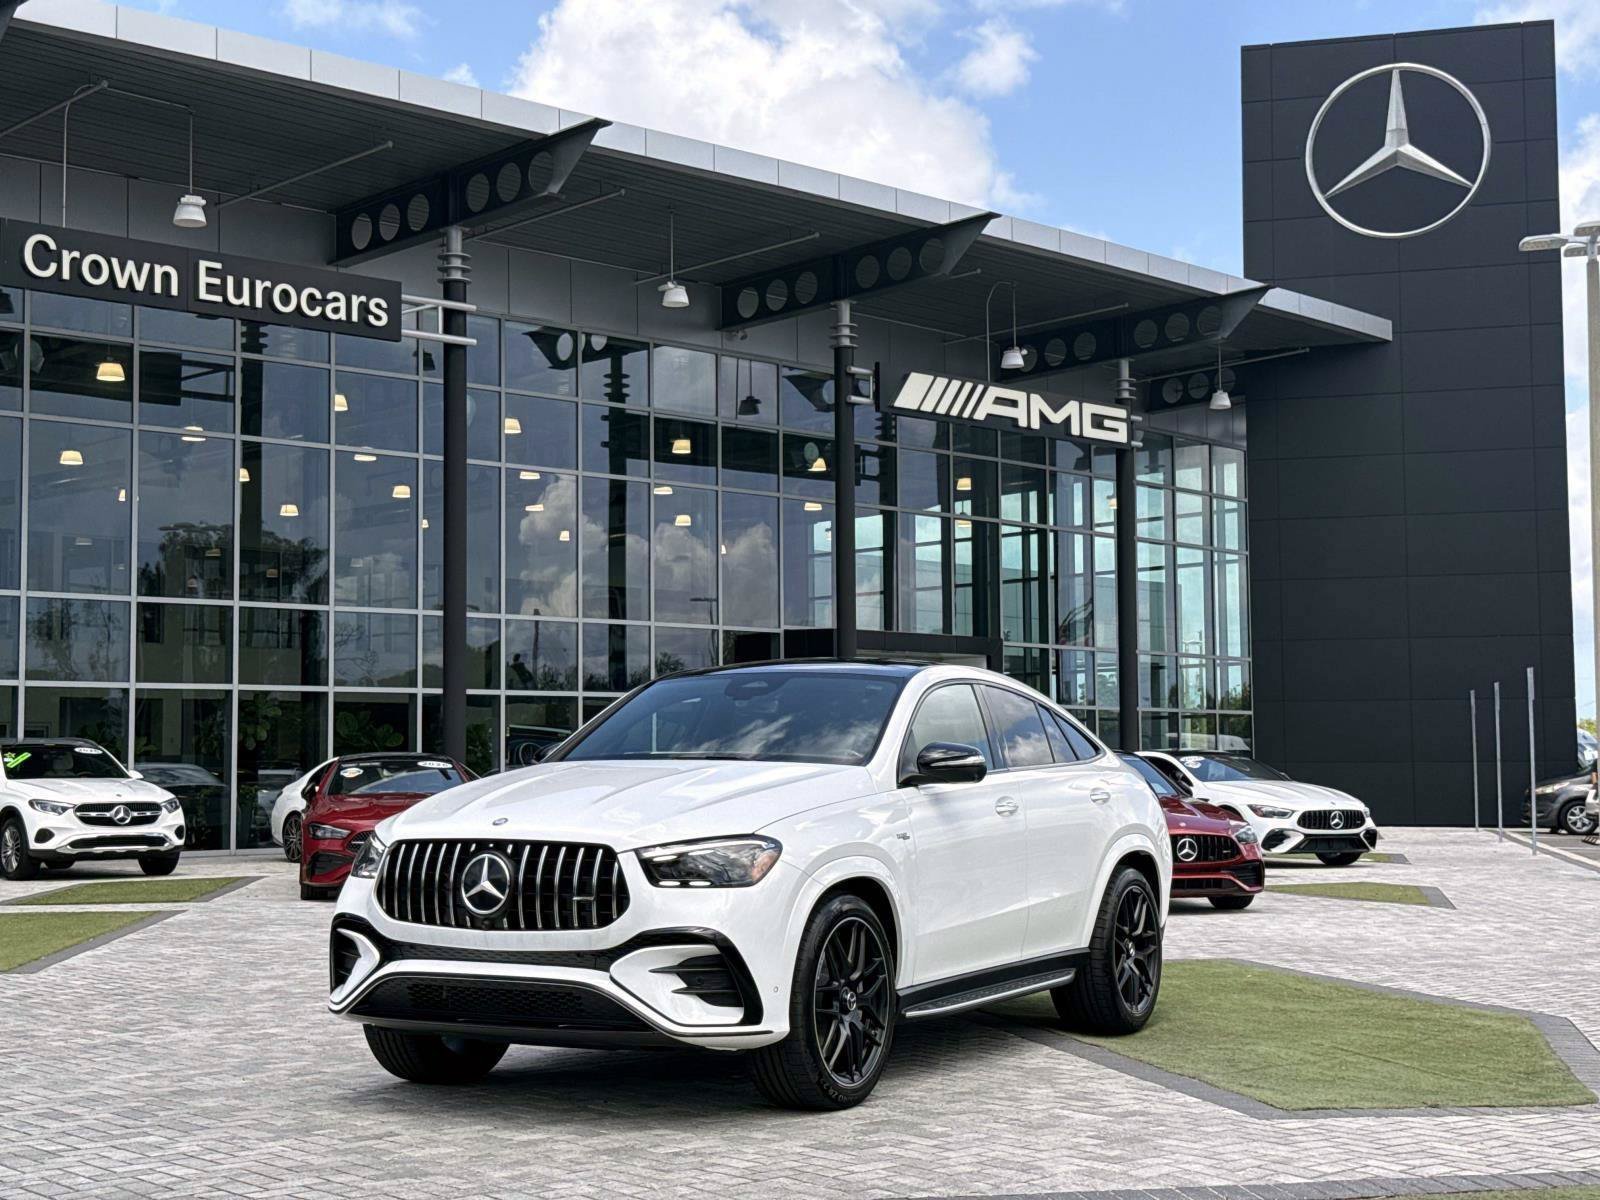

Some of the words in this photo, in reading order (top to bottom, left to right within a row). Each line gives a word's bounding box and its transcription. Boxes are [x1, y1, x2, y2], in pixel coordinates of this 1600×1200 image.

[23, 233, 179, 297] Crown
[197, 259, 389, 328] Eurocars
[973, 385, 1128, 444] AMG
